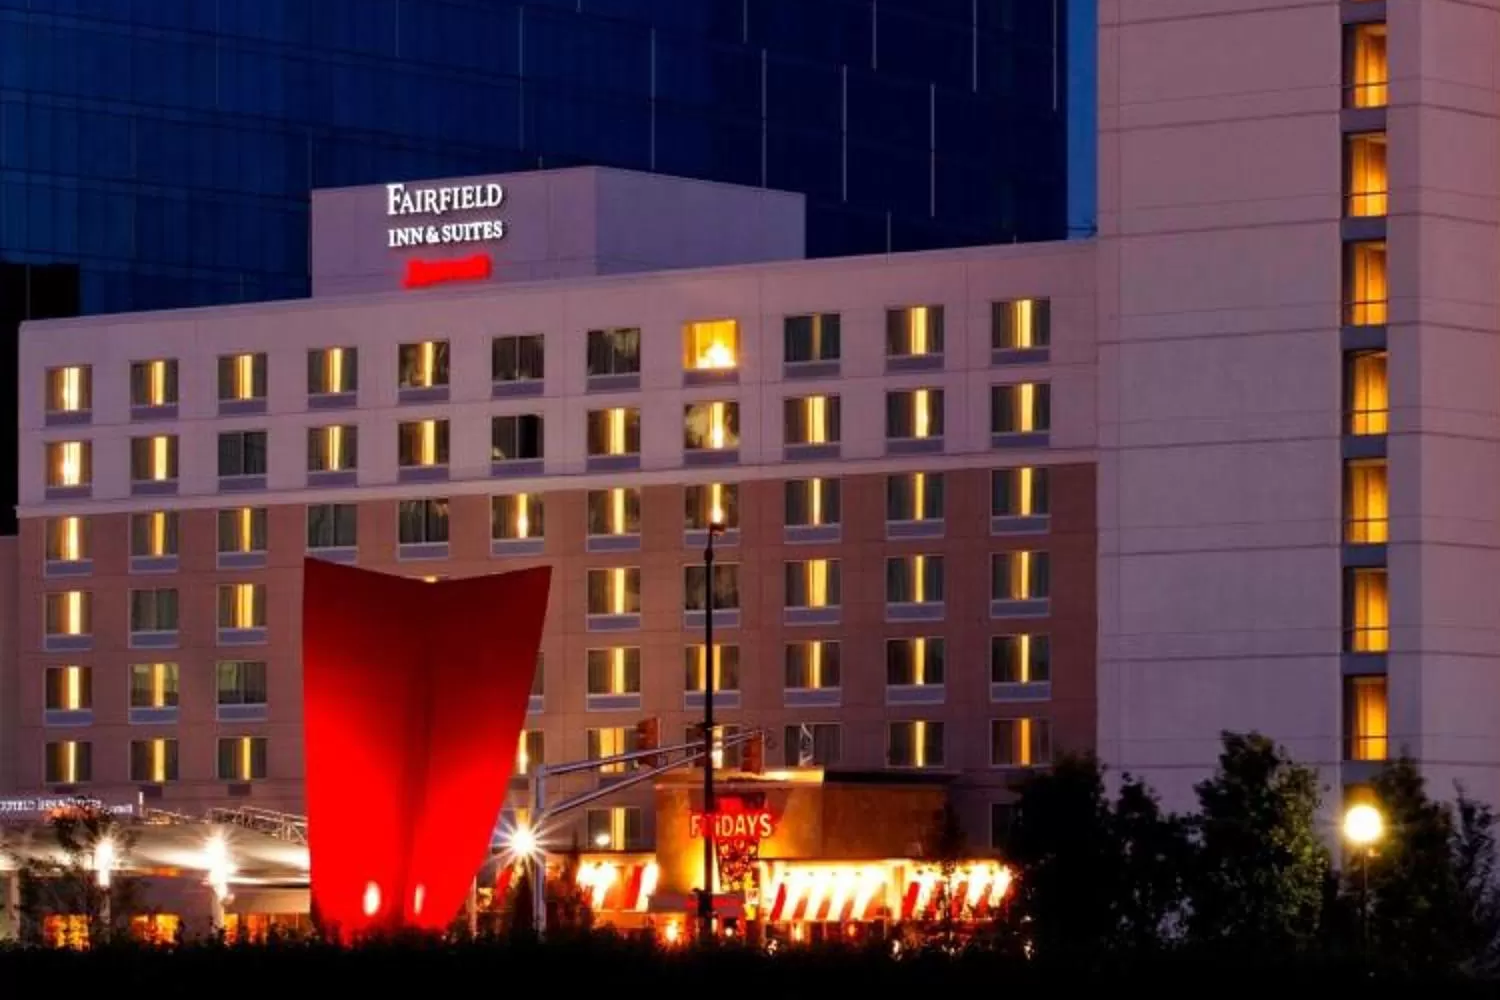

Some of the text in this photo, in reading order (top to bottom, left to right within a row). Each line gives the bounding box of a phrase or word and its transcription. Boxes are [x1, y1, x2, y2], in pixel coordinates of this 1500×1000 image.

[386, 183, 503, 215] FAIRFIELD
[388, 225, 424, 247] INN
[441, 221, 503, 243] SUITES
